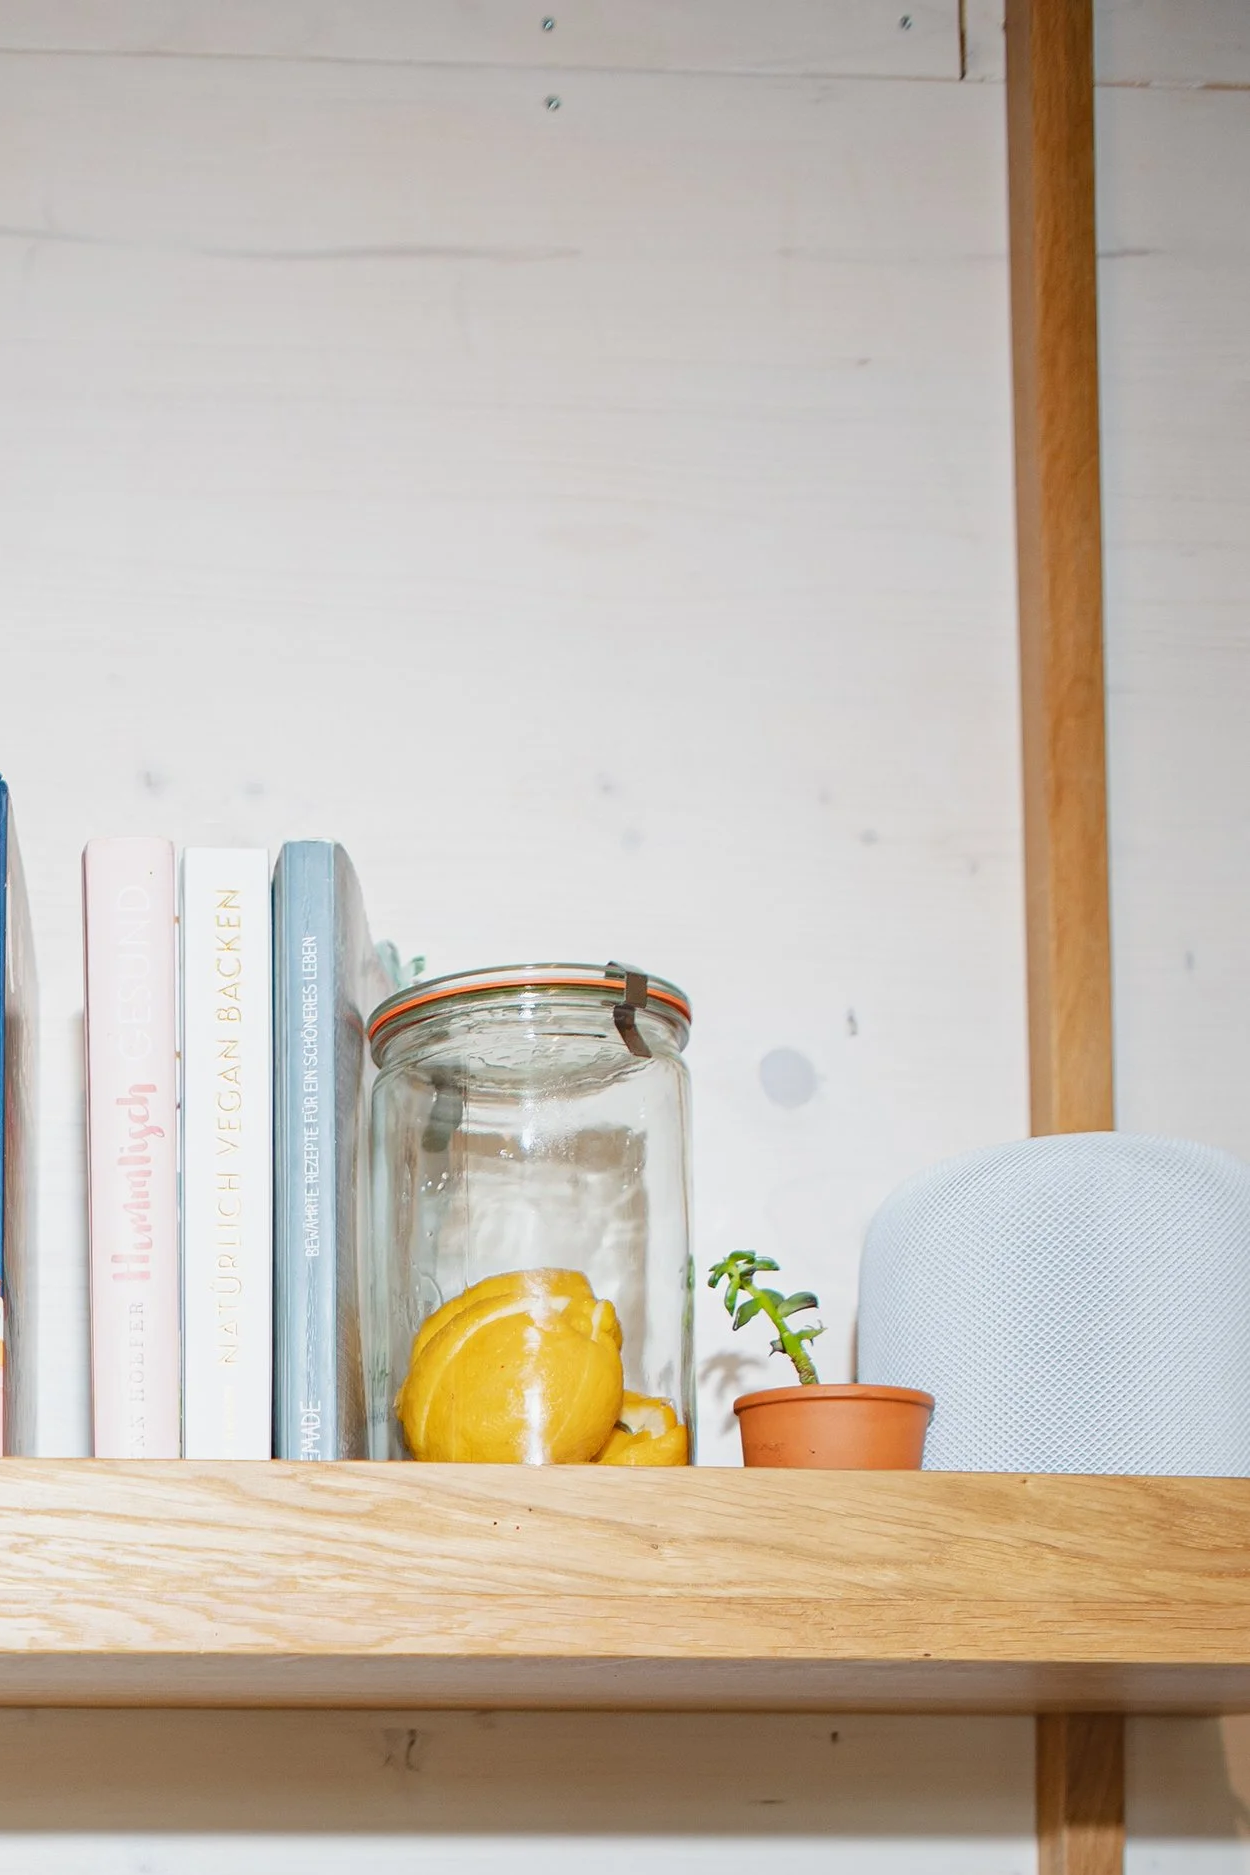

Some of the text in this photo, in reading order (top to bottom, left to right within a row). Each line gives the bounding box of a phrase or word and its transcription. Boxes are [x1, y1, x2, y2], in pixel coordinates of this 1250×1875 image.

[116, 884, 152, 1062] GESUND
[215, 889, 242, 1023] BACKEN
[301, 935, 318, 981] LEBEN
[301, 983, 319, 1067] SCHÖNERES
[216, 1039, 242, 1156] VEGAN
[301, 1096, 319, 1123] FÜR
[302, 1069, 319, 1093] EIN
[302, 1126, 320, 1183] REZEPTE
[302, 1187, 320, 1257] BEWÄHRTE
[209, 1173, 243, 1365] NATÜRLICH
